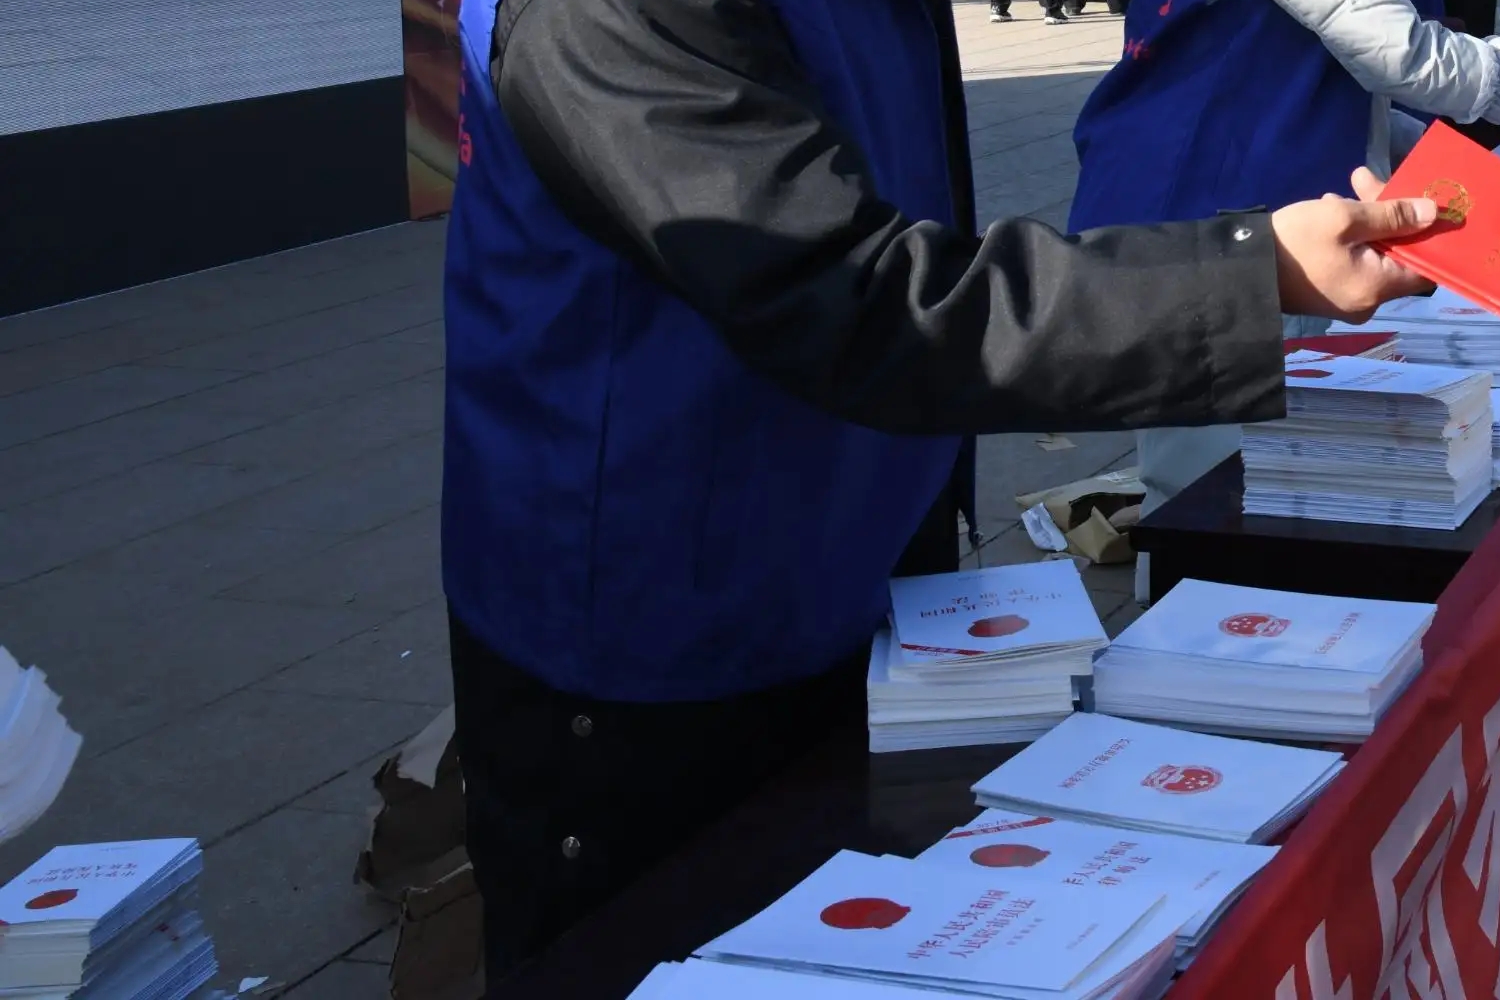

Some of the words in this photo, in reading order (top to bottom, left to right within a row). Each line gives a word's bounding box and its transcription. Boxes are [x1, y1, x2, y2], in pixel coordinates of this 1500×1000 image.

[906, 889, 1010, 959] 中华人民共和国
